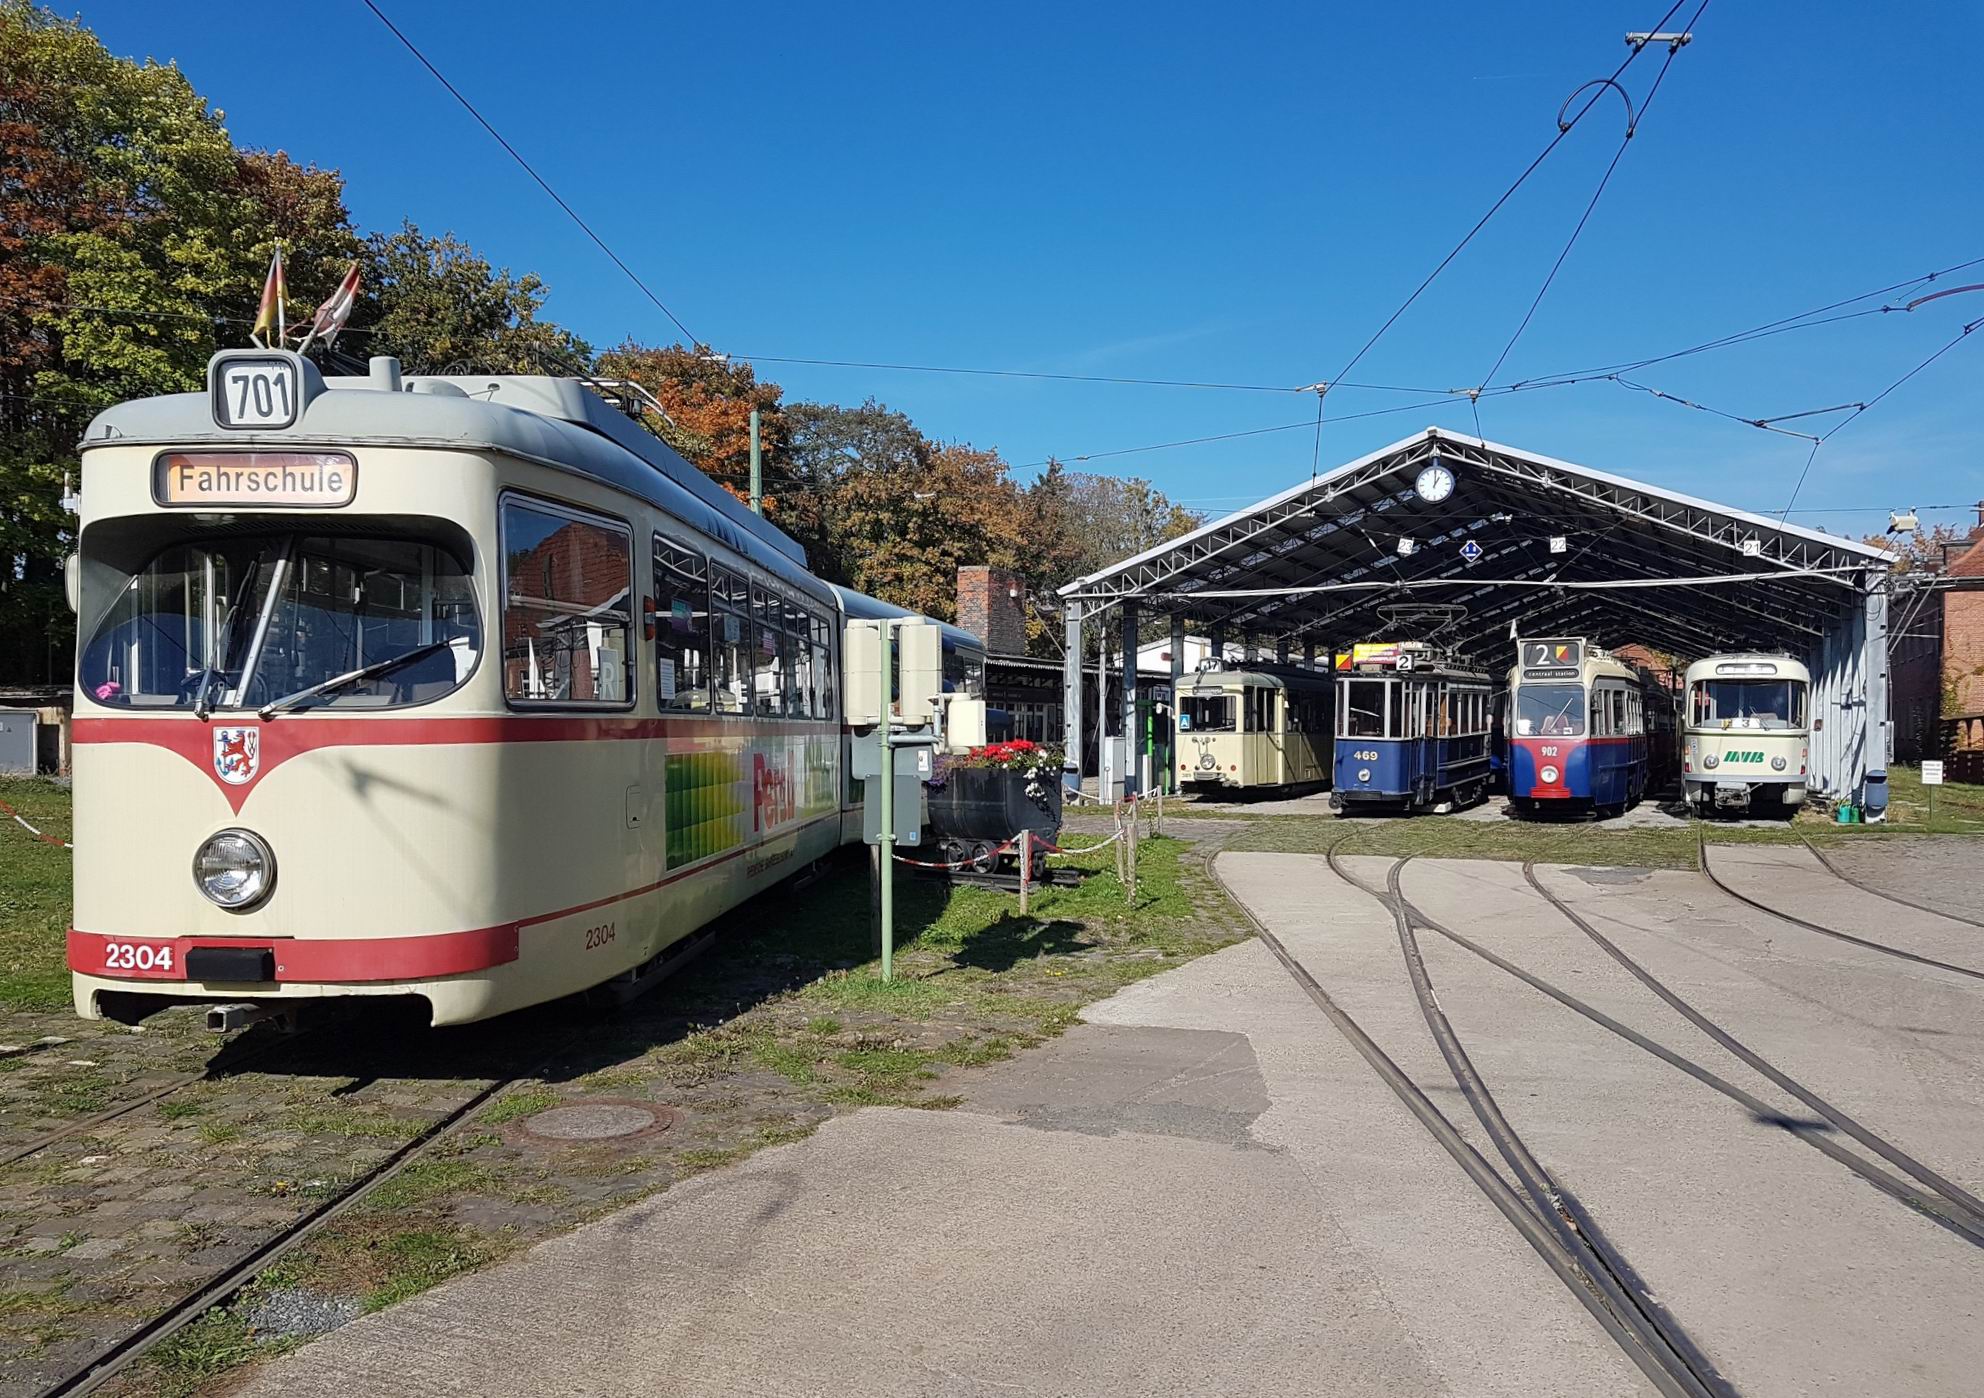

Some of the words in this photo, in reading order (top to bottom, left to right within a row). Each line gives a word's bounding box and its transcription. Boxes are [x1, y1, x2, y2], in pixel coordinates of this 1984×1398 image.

[231, 372, 290, 419] 701
[180, 465, 343, 493] Fahrschule
[1400, 541, 1413, 551] 23
[1551, 541, 1566, 551] 22
[1744, 542, 1759, 554] 21
[1535, 644, 1551, 665] 2
[1399, 655, 1409, 669] 2
[1180, 717, 1189, 727] A
[1742, 719, 1750, 728] 3
[1353, 750, 1378, 761] 469
[1541, 746, 1558, 757] 902
[586, 921, 616, 951] 2304
[105, 943, 173, 971] 2304
